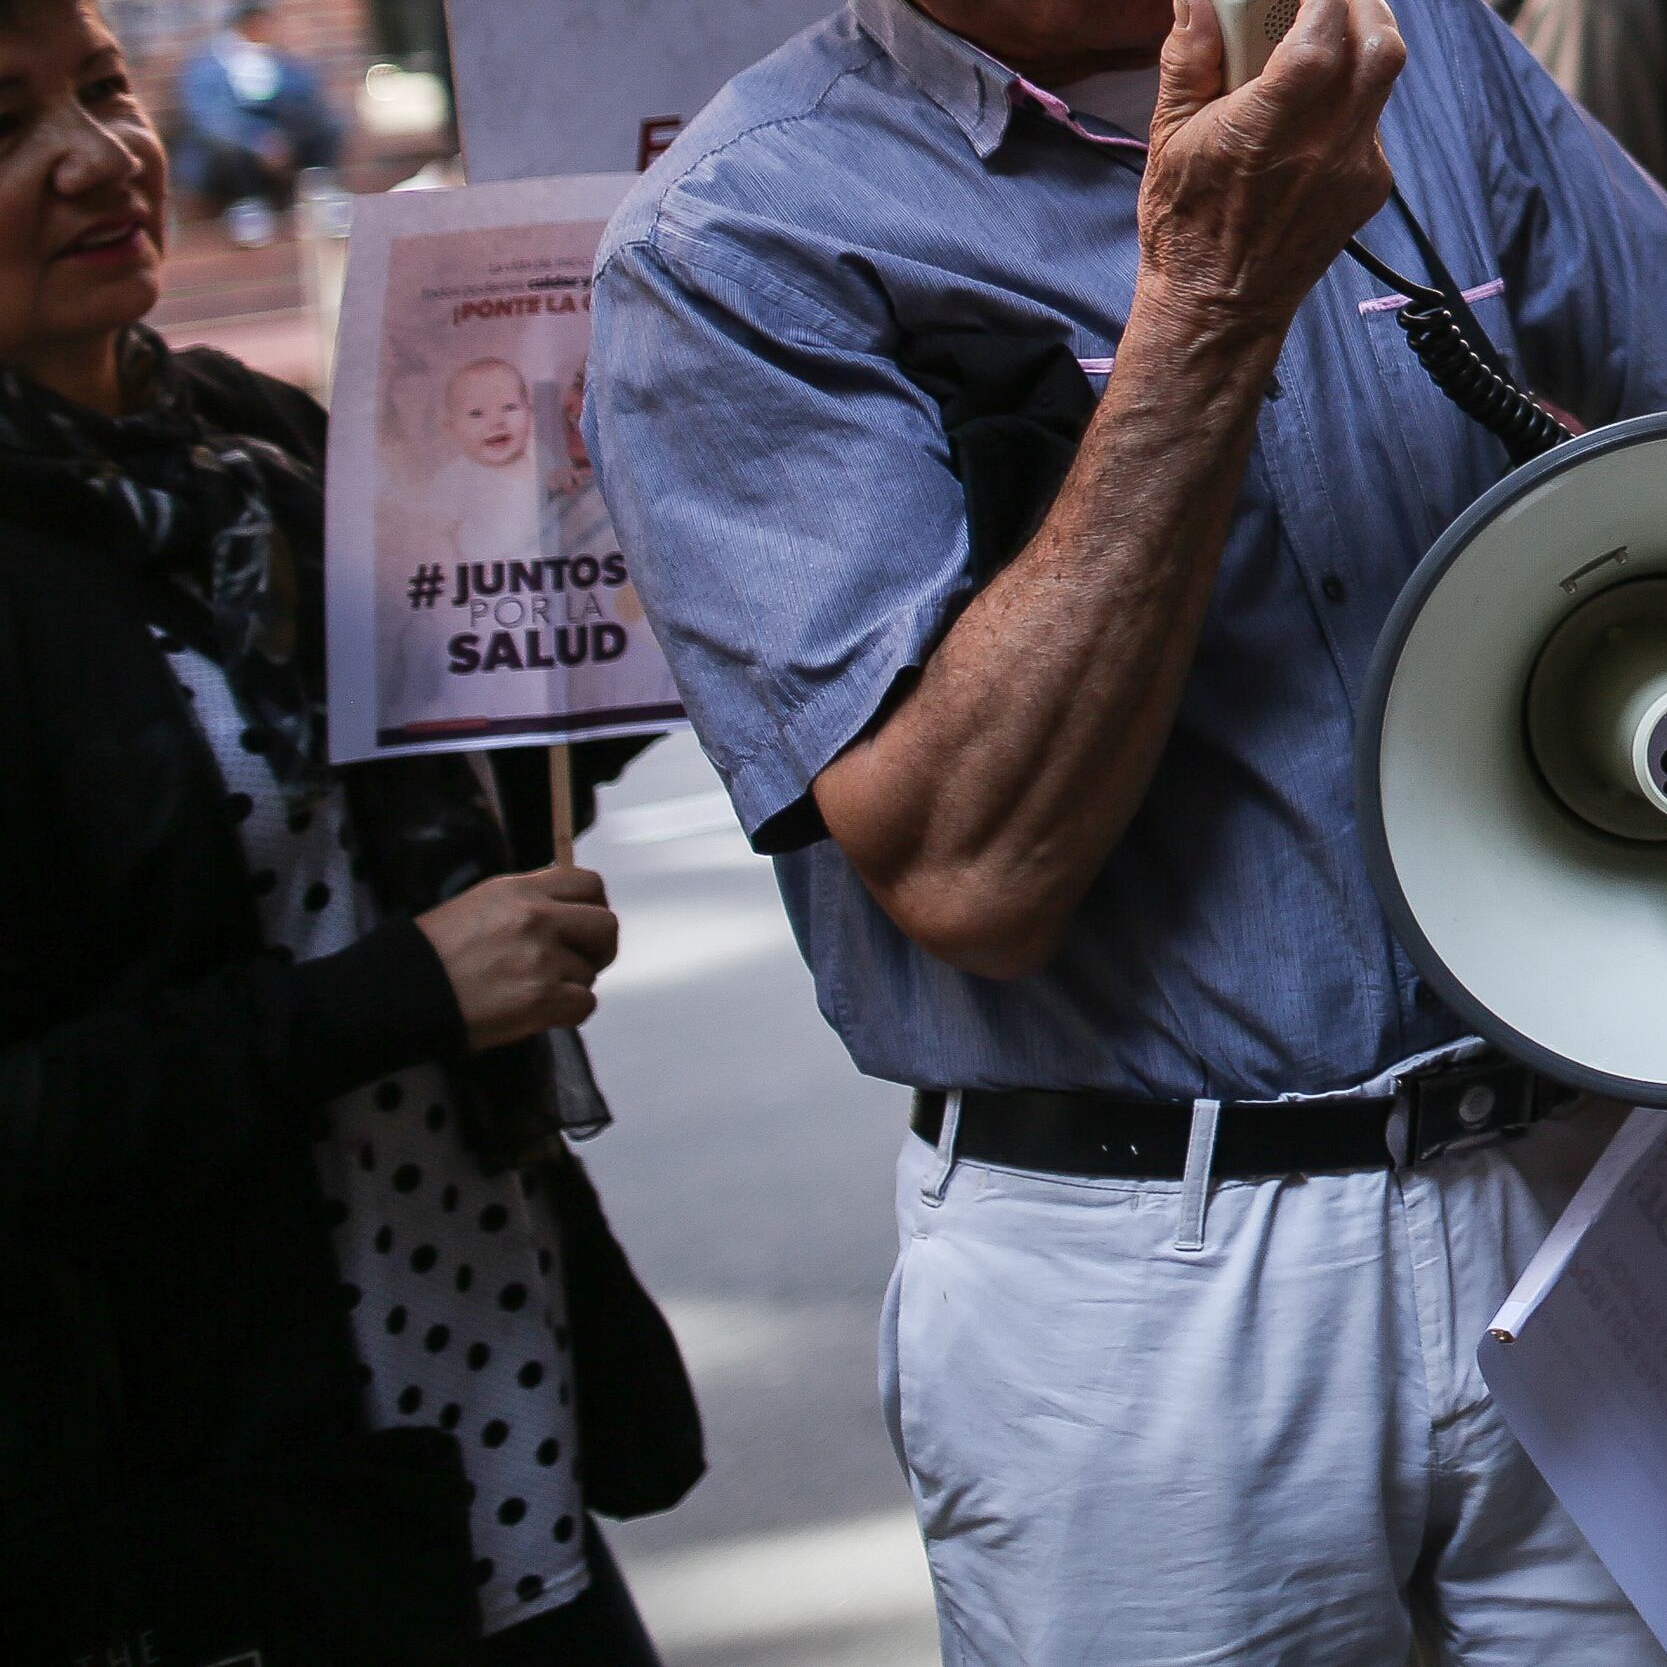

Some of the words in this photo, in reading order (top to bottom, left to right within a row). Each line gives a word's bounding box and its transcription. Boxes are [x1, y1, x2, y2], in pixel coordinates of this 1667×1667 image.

[470, 596, 551, 628] POR
[566, 591, 604, 624] LA
[448, 620, 628, 676] SALUD
